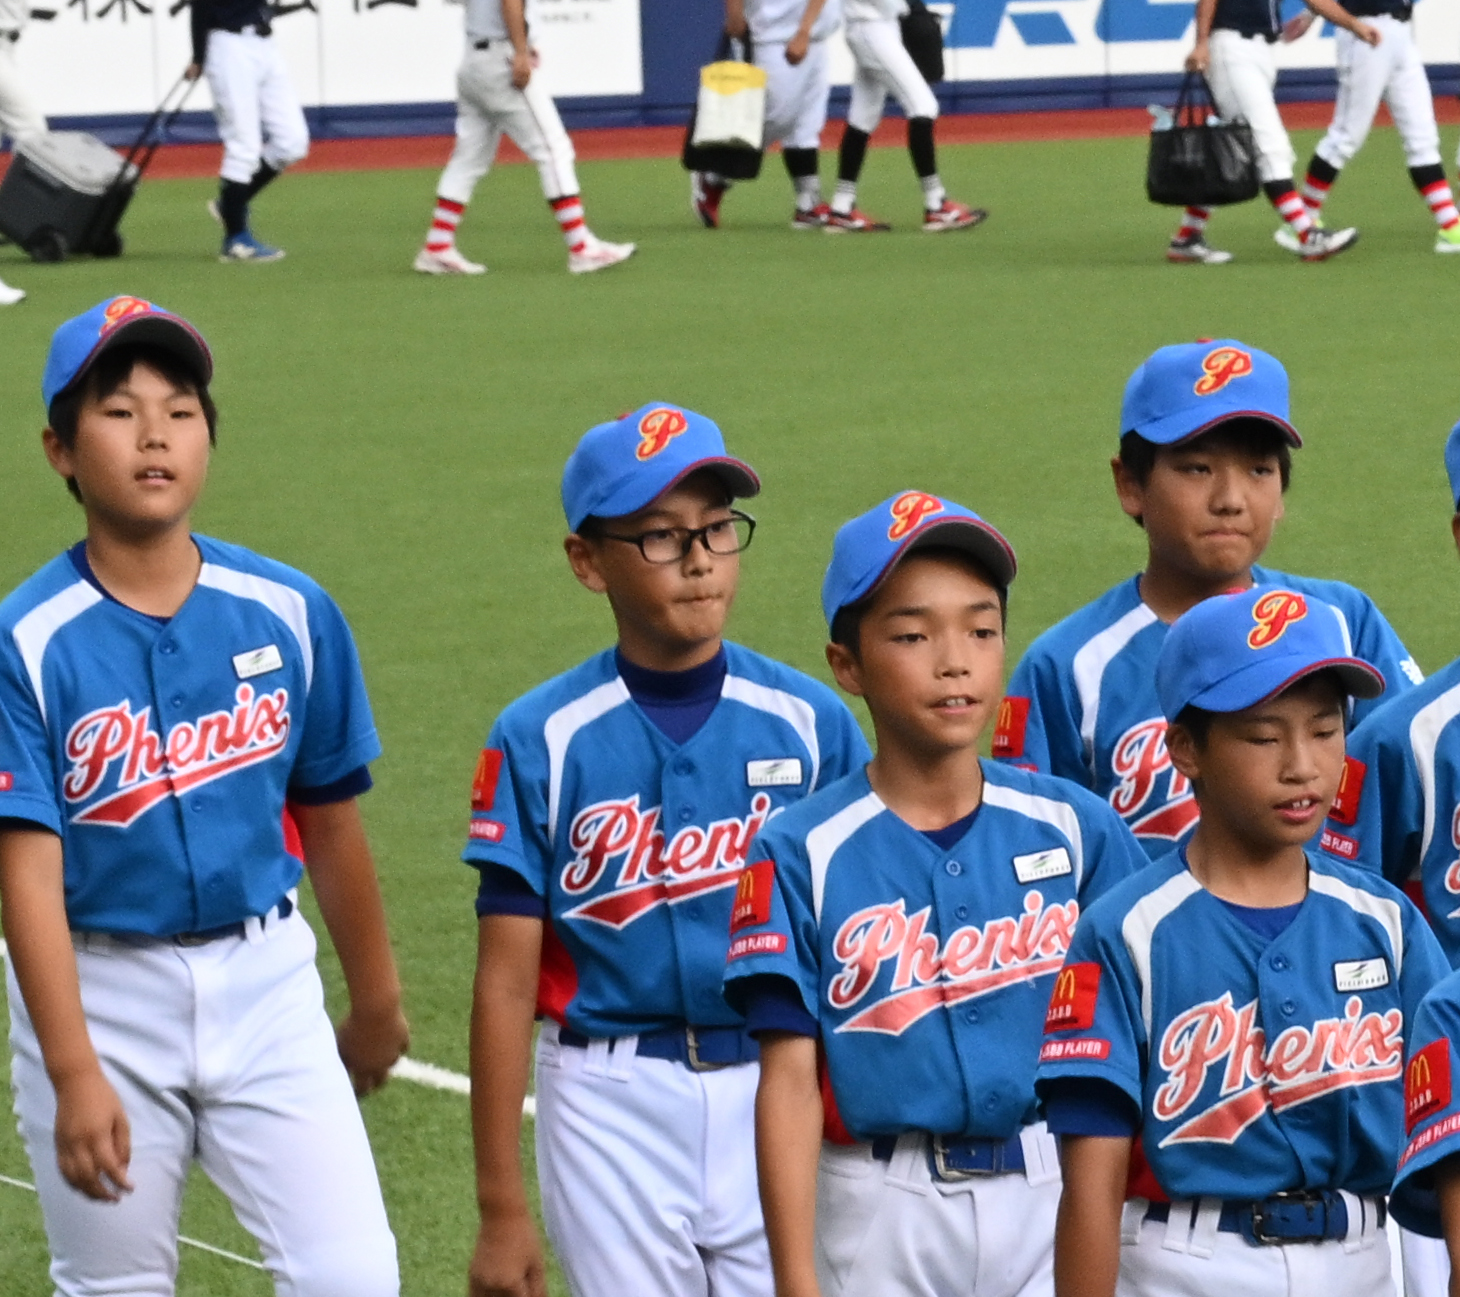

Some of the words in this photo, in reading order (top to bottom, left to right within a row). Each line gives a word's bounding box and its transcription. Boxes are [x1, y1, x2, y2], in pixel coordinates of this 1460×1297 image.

[1194, 346, 1252, 396] P
[636, 407, 689, 460] P
[888, 491, 944, 542] P
[1249, 590, 1308, 649] P
[63, 683, 290, 802] Phenix
[561, 792, 785, 894] Pheni
[829, 890, 1080, 1008] Phenix
